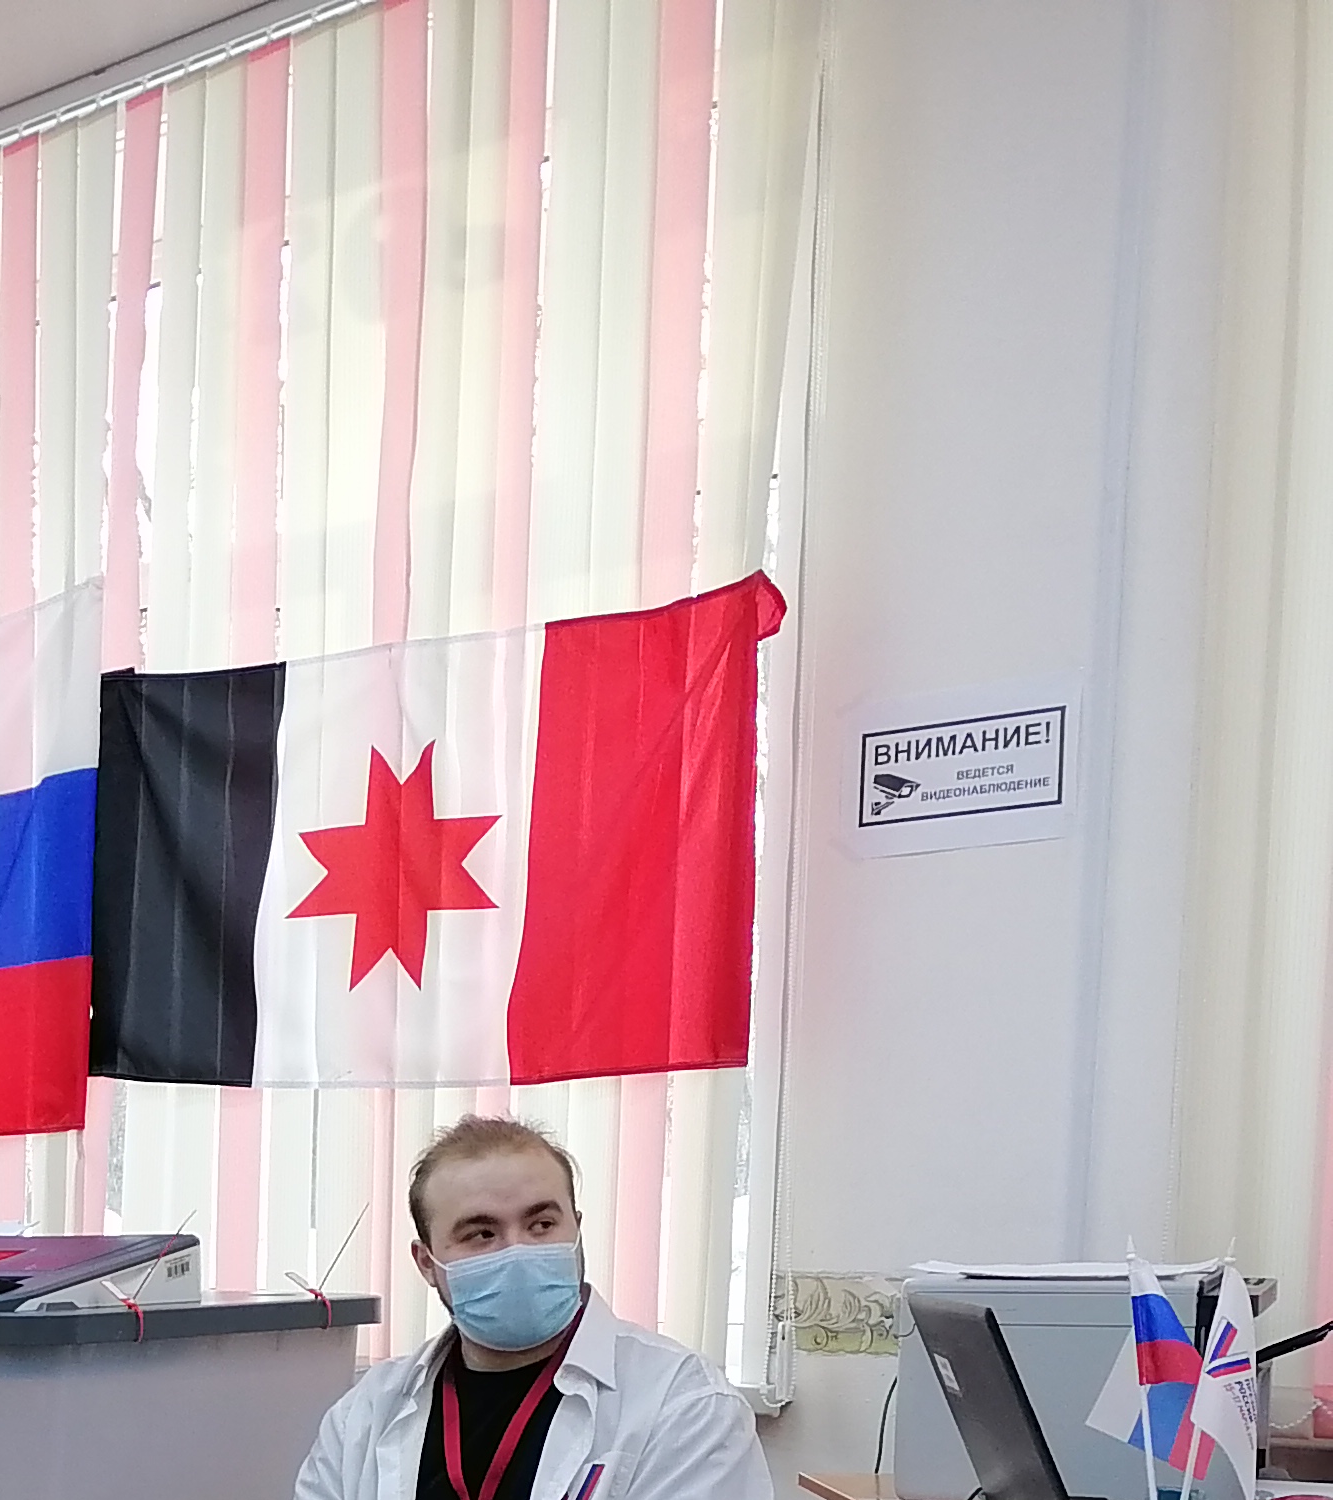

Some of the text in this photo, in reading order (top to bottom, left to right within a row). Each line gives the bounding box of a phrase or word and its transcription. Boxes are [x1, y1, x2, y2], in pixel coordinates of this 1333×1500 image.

[874, 721, 1052, 766] ВНИМАНИЕ!
[957, 764, 1014, 781] ВЕДЕТСЯ
[920, 777, 1051, 802] ВИДЕОНАБЛЮДЕНИЕ
